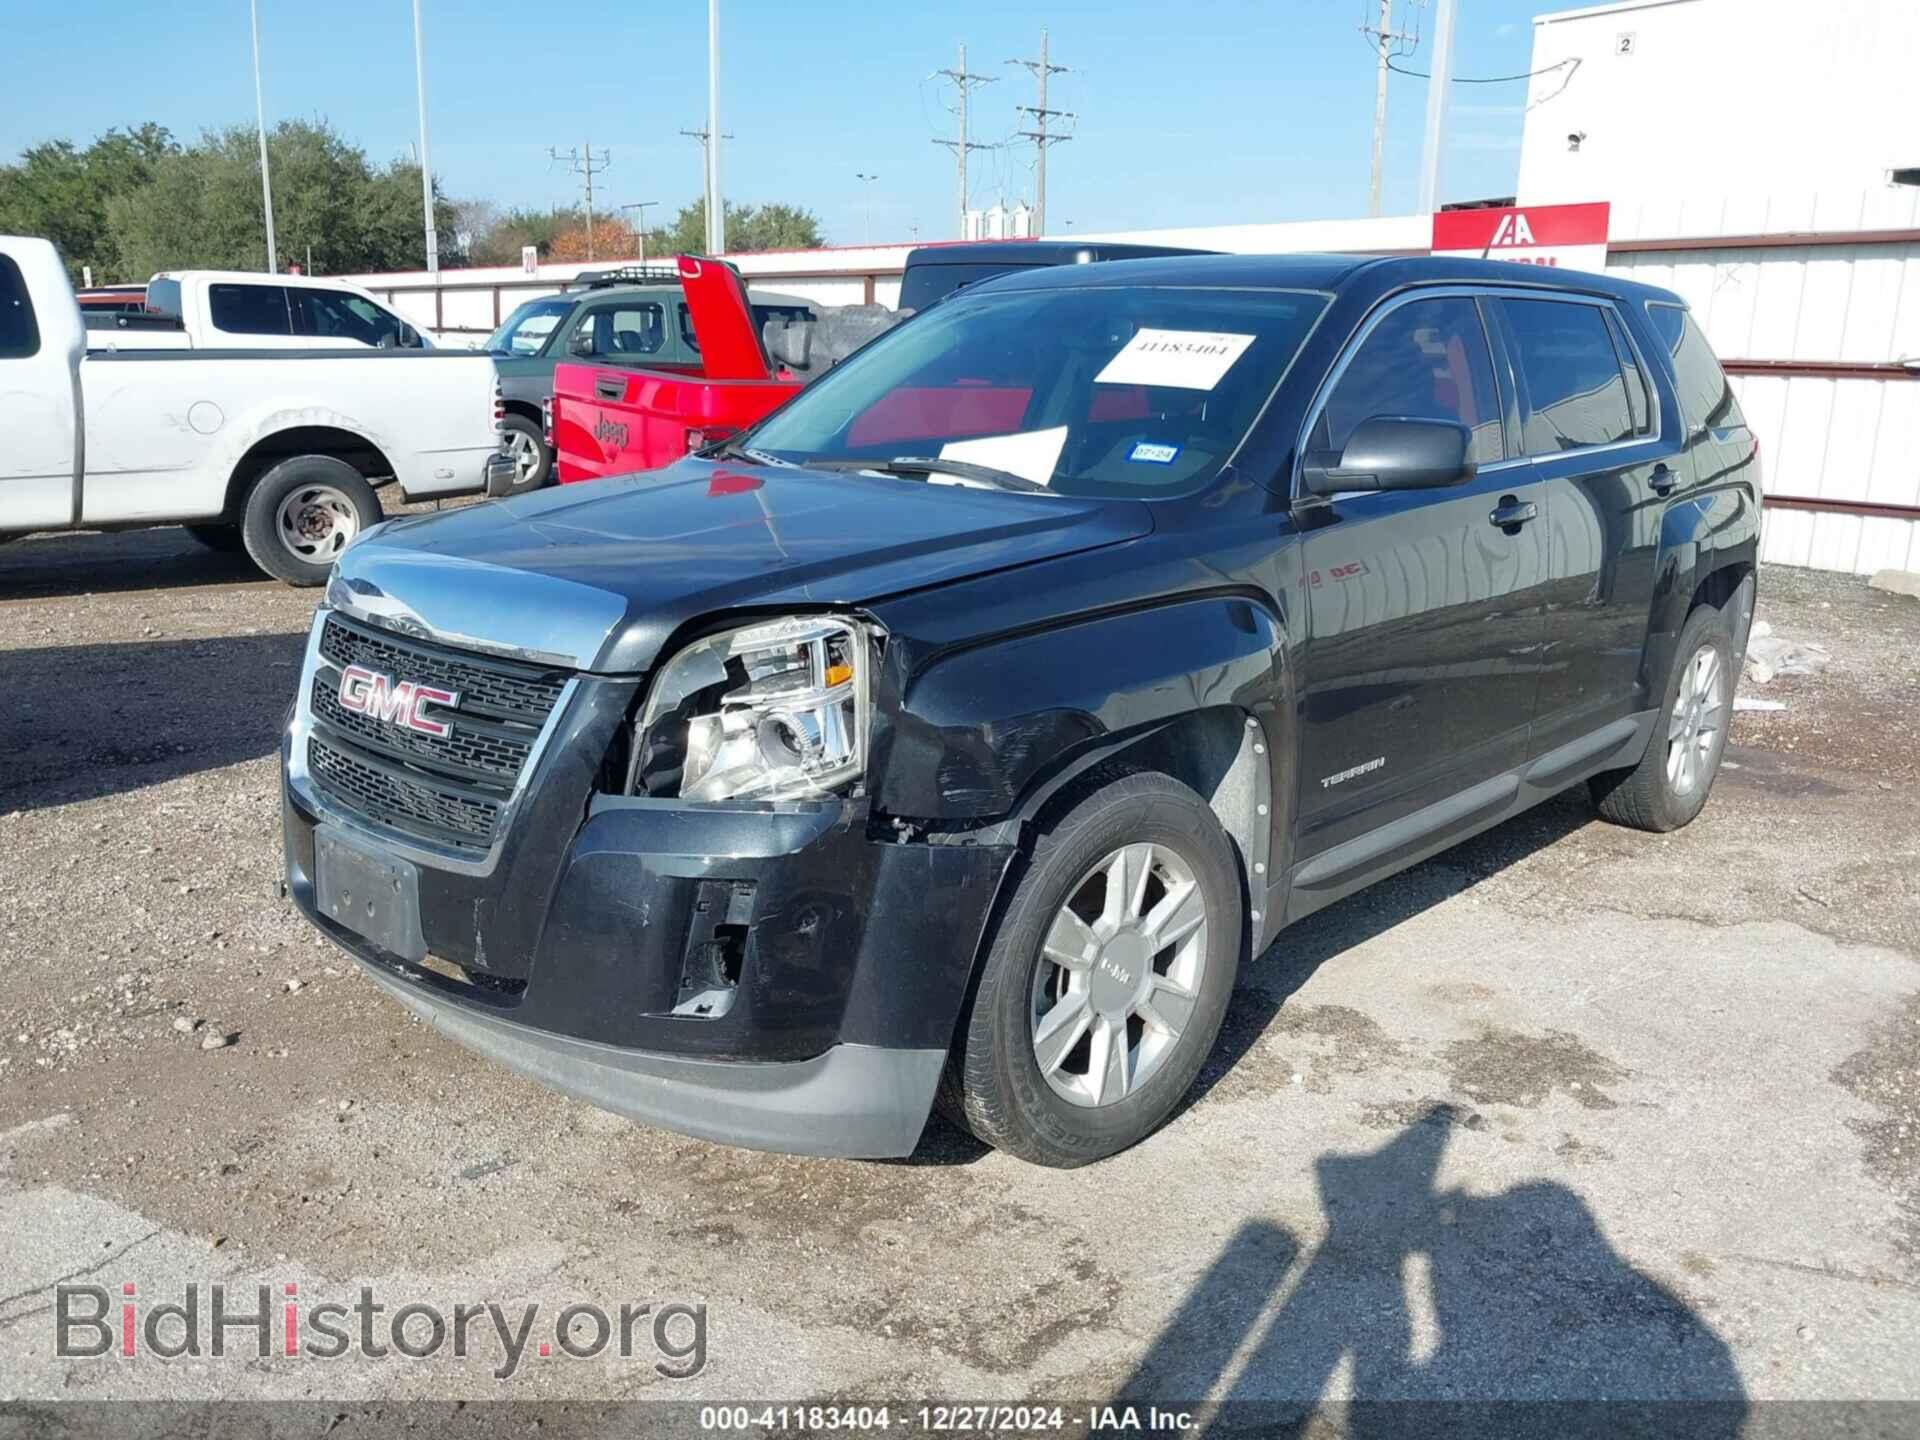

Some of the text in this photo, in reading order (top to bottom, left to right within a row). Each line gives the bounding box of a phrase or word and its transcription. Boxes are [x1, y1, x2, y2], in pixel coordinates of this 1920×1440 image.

[1620, 38, 1630, 52] 2
[594, 410, 630, 452] Jeep
[338, 664, 462, 740] GMC
[1320, 756, 1385, 788] TERRAIN
